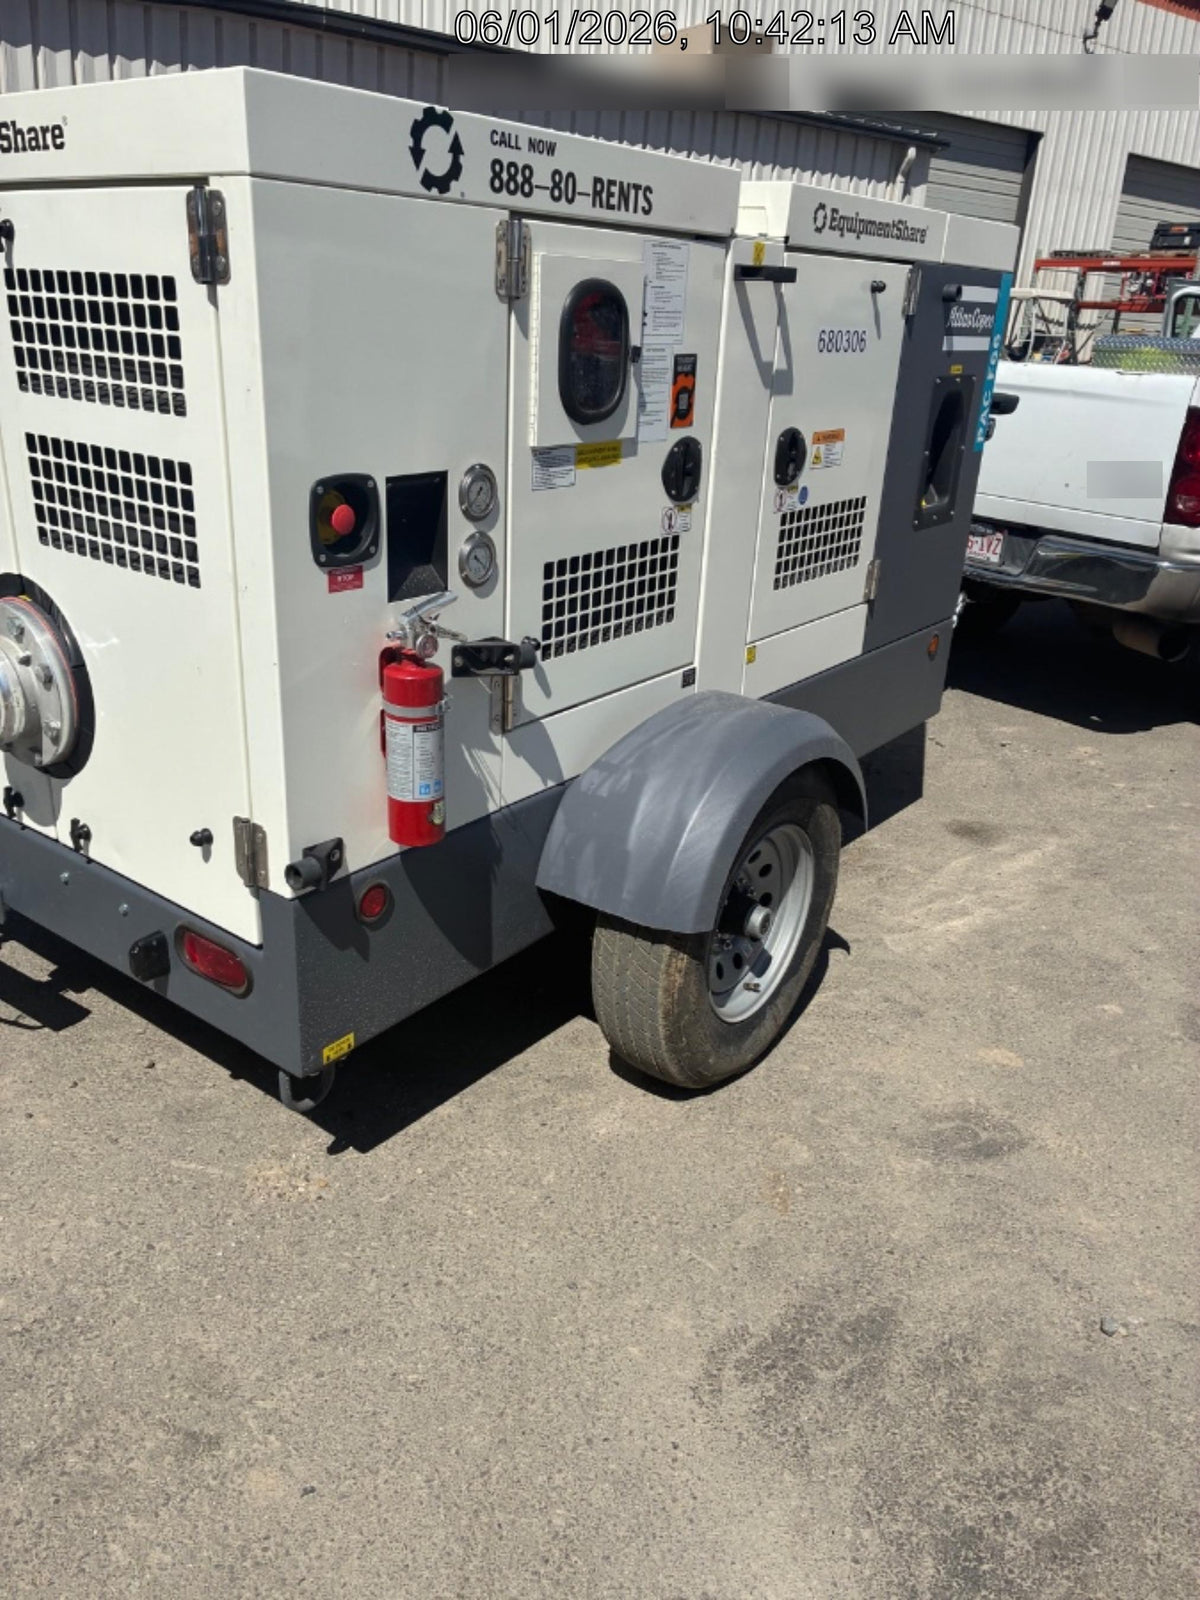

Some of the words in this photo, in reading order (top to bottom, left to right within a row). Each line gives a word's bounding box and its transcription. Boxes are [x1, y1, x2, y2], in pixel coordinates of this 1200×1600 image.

[490, 129, 521, 150] CALL
[528, 137, 557, 157] NOW
[489, 158, 653, 216] 888-80-RENTS
[828, 207, 927, 244] EquipmentShare
[946, 305, 972, 328] Atlas
[817, 329, 867, 353] 680306
